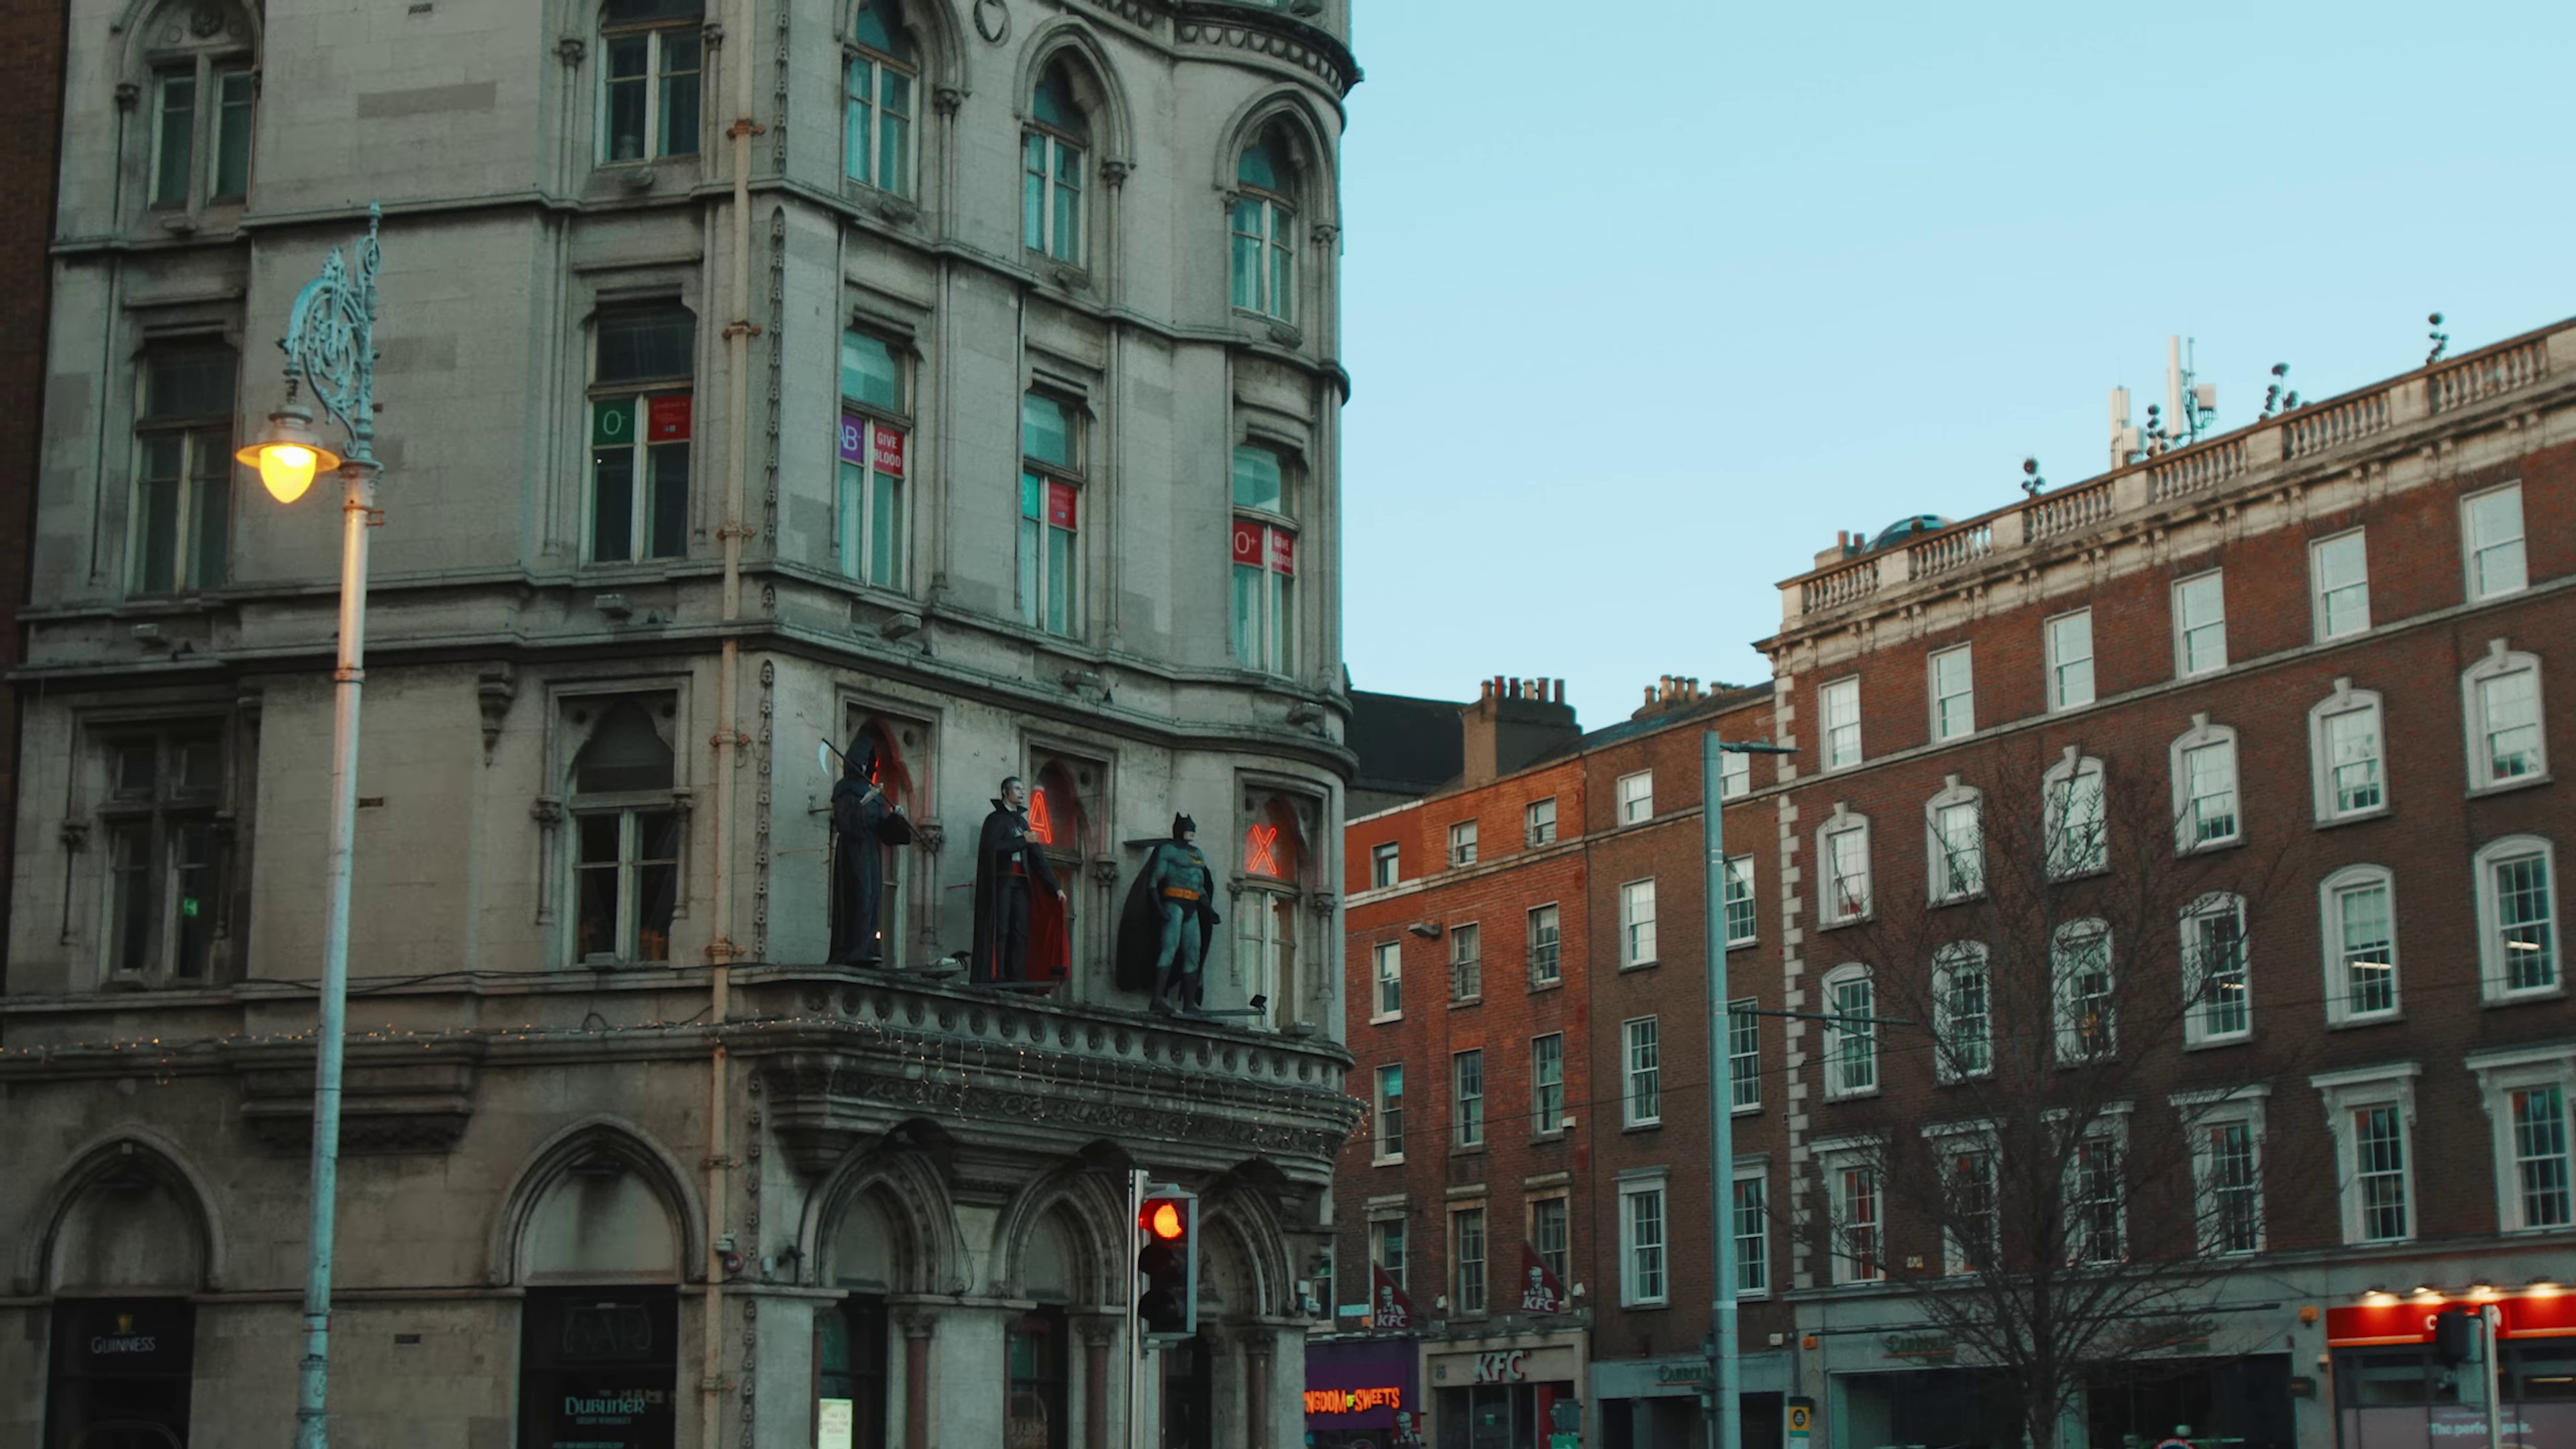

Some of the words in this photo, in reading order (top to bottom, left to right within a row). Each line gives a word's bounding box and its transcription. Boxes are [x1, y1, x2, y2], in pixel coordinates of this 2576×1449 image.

[877, 432, 898, 449] GIVE
[874, 448, 902, 468] BLOOD
[1250, 824, 1277, 875] X
[1522, 1296, 1555, 1311] KFC
[1376, 1314, 1407, 1328] KFC
[91, 1336, 156, 1354] GUINNESS
[1474, 1350, 1526, 1382] KFC
[1303, 1389, 1348, 1414] NGDOM
[1346, 1394, 1355, 1407] OF
[1354, 1387, 1400, 1413] SWEETS
